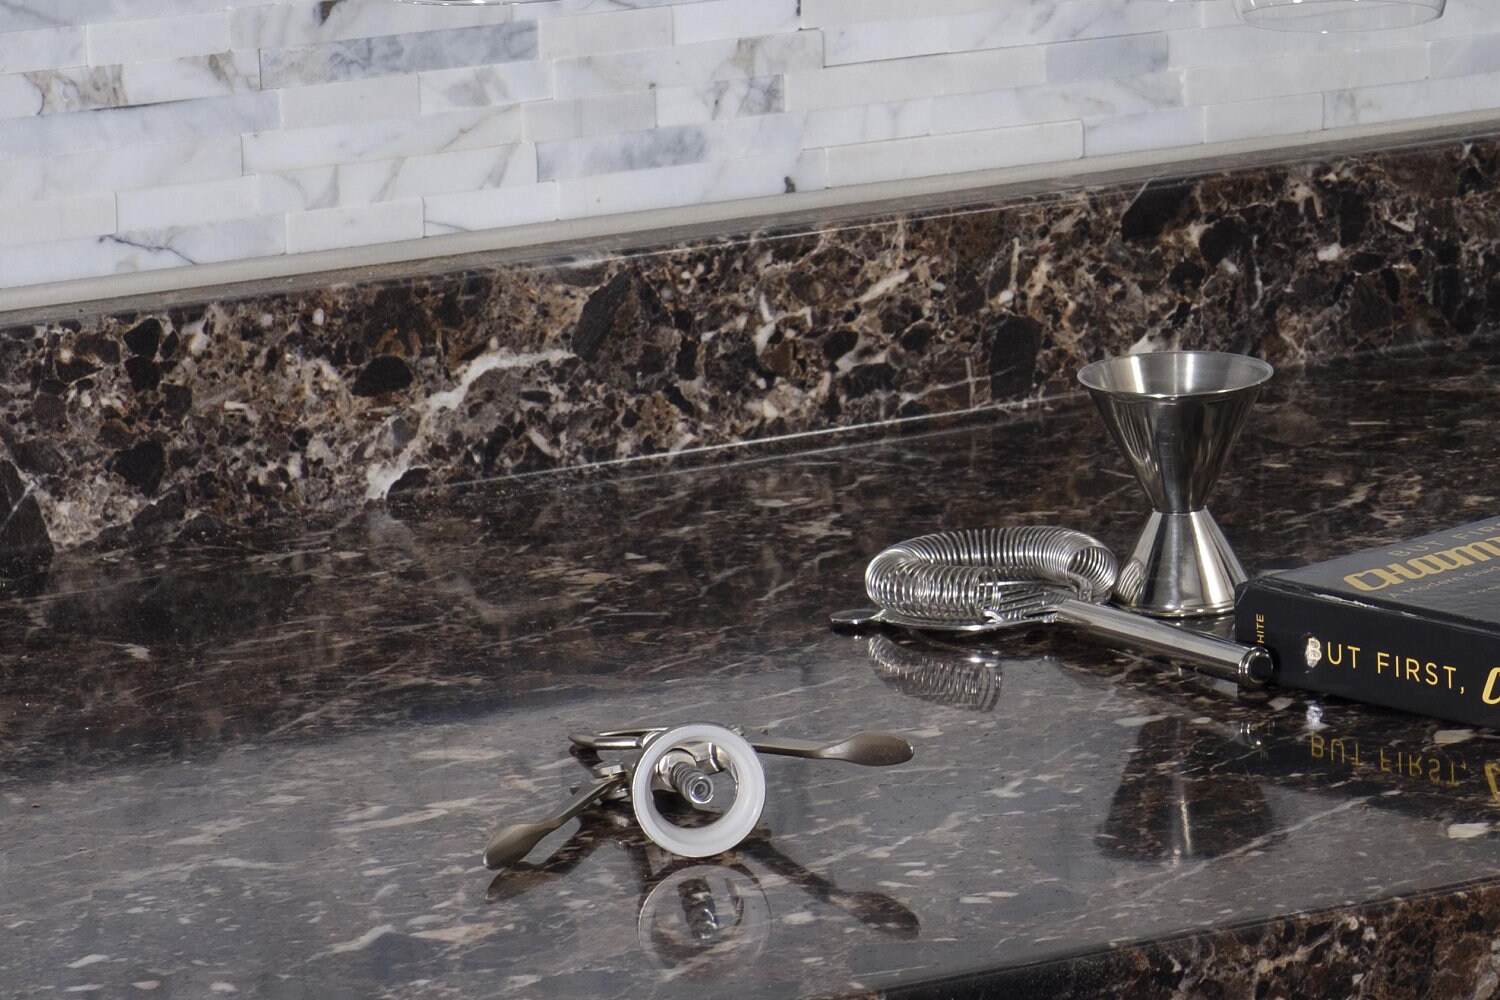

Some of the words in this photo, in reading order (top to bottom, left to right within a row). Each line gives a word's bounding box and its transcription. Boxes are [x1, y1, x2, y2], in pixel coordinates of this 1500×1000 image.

[1387, 540, 1445, 557] BUT
[1256, 613, 1265, 646] HITE
[1307, 636, 1361, 669] BUT
[1377, 651, 1465, 695] FIRST,
